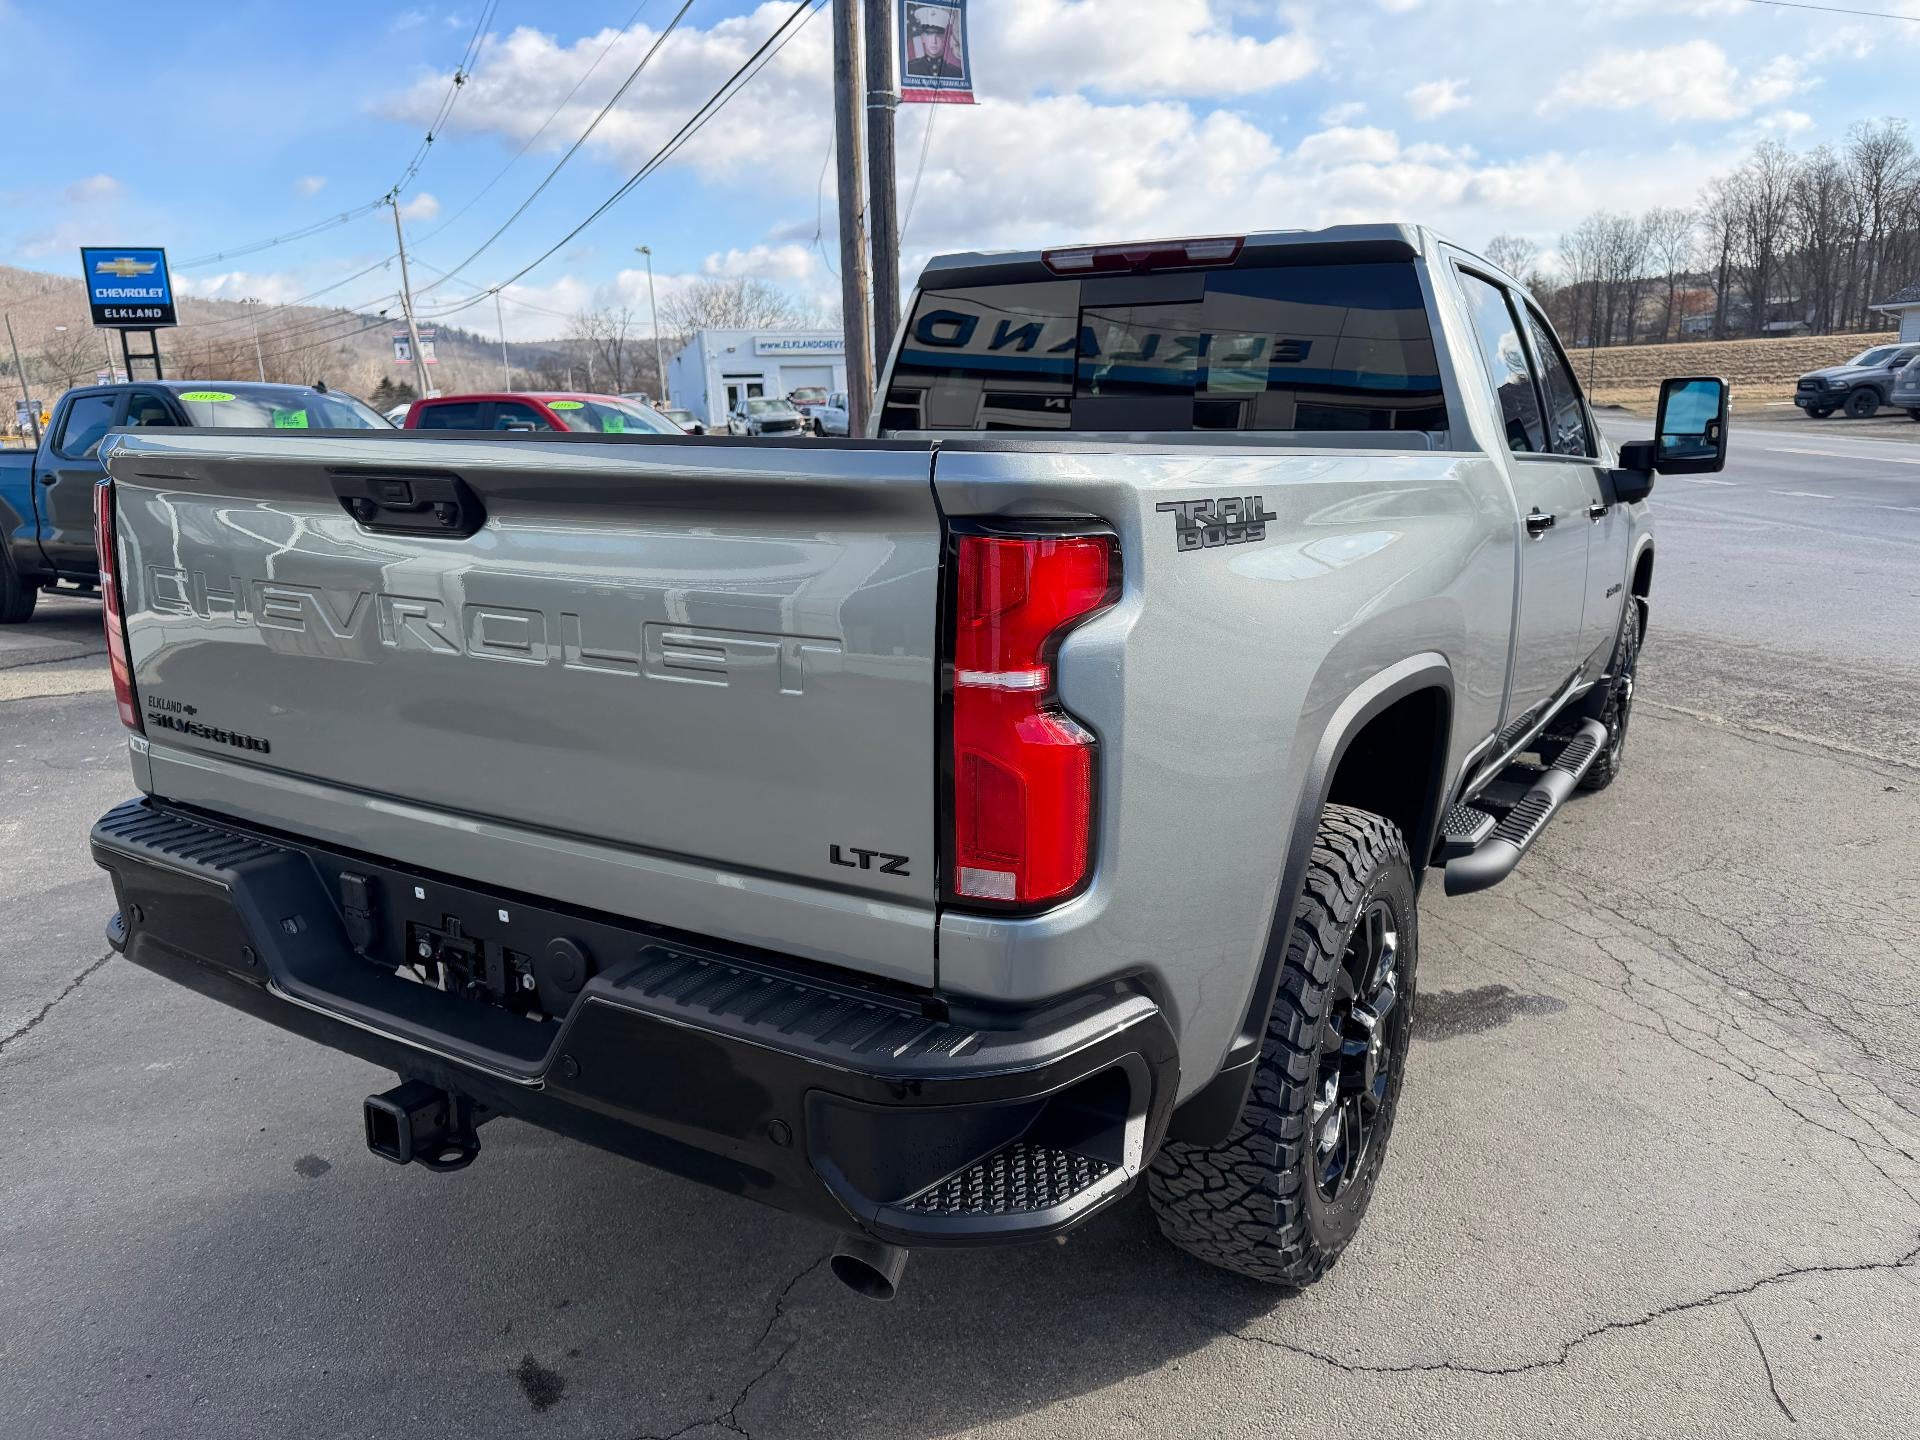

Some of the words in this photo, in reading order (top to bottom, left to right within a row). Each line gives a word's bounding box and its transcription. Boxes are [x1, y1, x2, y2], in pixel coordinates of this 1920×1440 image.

[95, 287, 164, 298] CHEVROLET
[104, 308, 162, 318] ELKLAND
[1156, 496, 1277, 529] TRAIL
[1177, 520, 1266, 552] BOSS
[148, 565, 842, 696] CHEVROLET
[148, 695, 183, 714] ELKLAND
[148, 713, 271, 754] SILVERADO
[829, 843, 911, 877] LTZ
